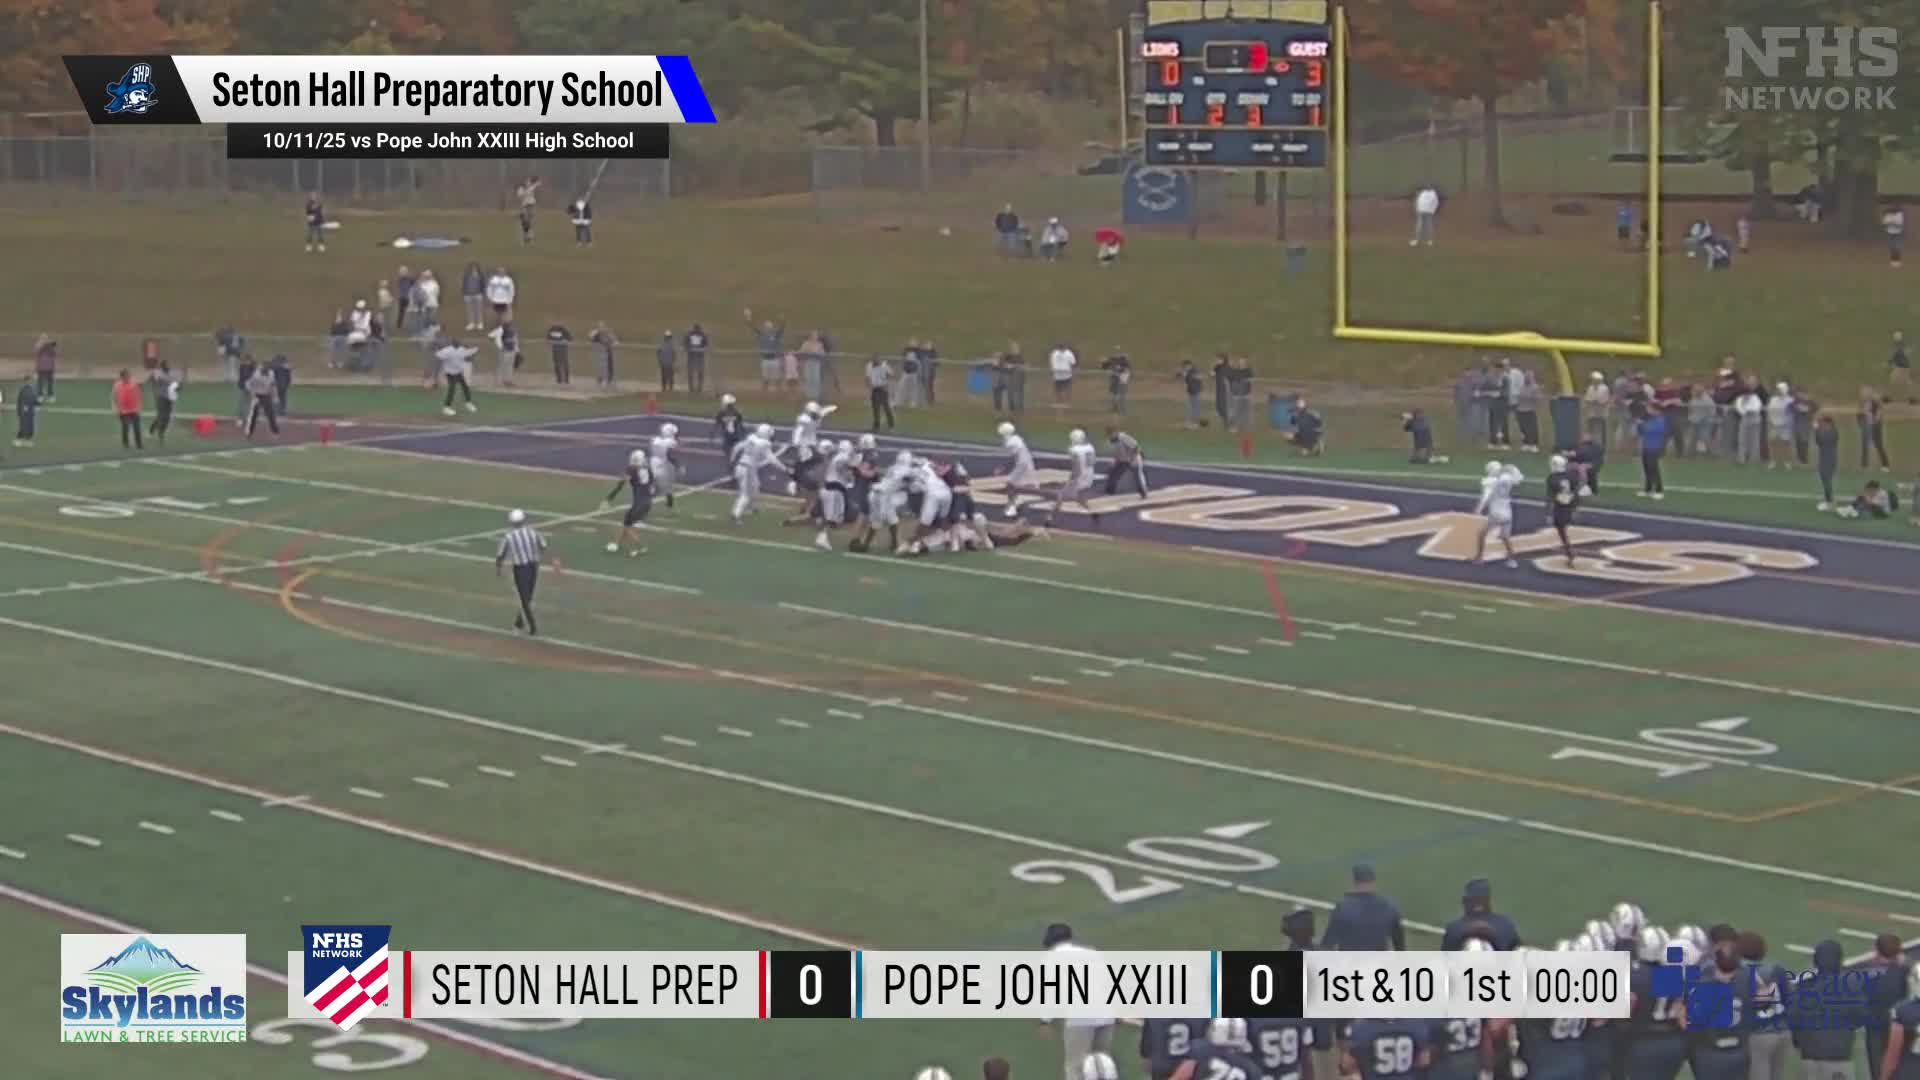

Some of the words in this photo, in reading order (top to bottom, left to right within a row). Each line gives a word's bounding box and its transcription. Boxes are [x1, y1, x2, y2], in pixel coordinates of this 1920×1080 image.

[1288, 42, 1329, 57] GUEST
[1160, 60, 1180, 86] 0
[1206, 103, 1224, 127] 2
[1010, 837, 1281, 904] 20
[1168, 1023, 1190, 1056] 2
[1260, 1027, 1299, 1068] 59
[1374, 1036, 1414, 1075] 58
